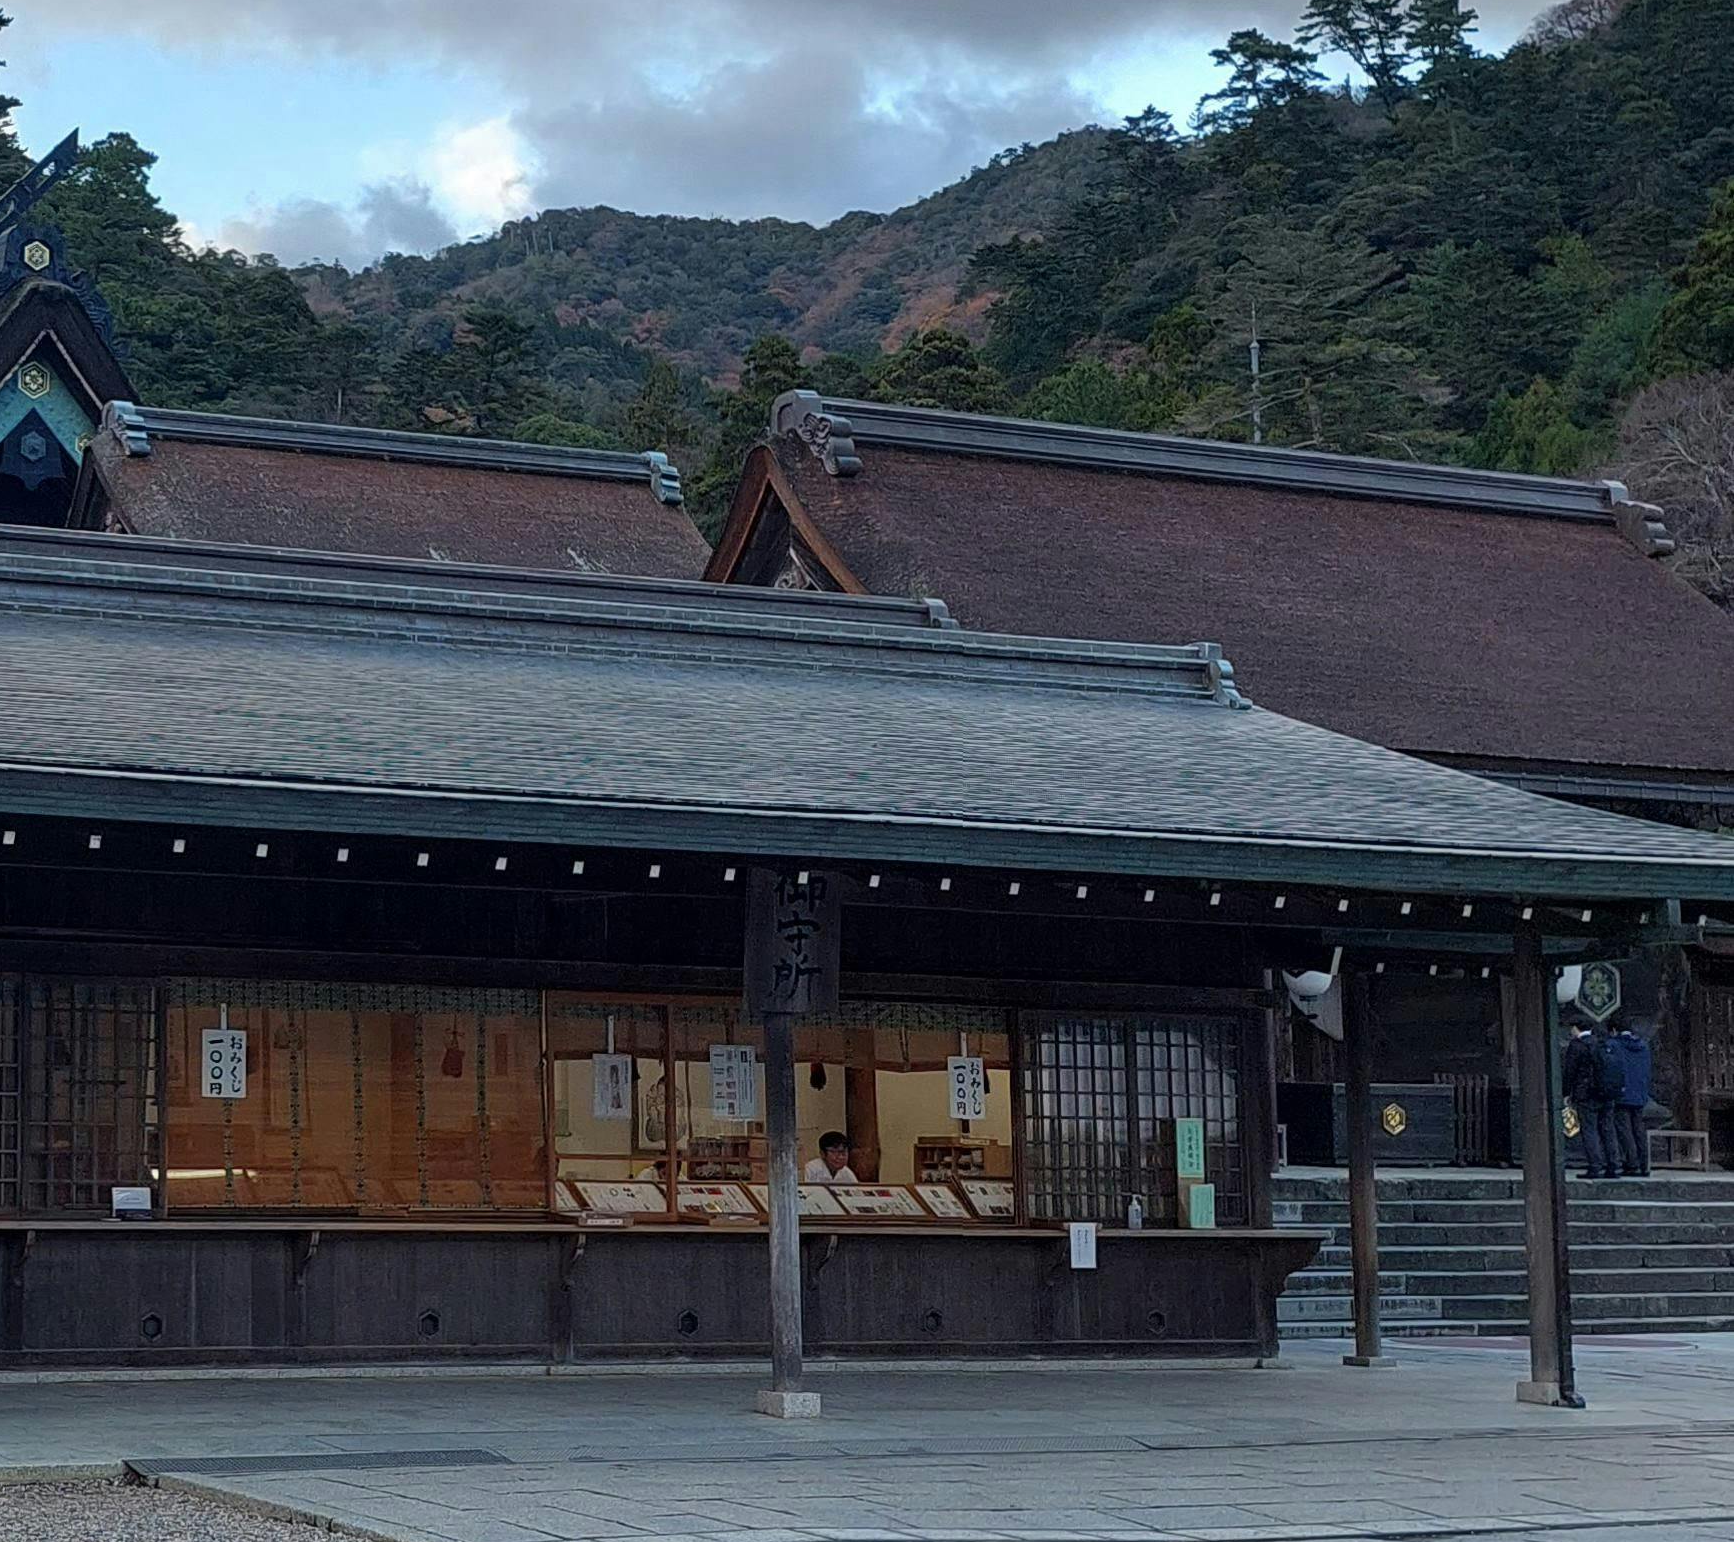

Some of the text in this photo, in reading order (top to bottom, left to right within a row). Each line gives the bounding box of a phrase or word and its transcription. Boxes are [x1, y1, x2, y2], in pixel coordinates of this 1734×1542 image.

[768, 873, 827, 1002] 御守所
[229, 1035, 243, 1093] おみくじ
[970, 1062, 981, 1116] おみくじ
